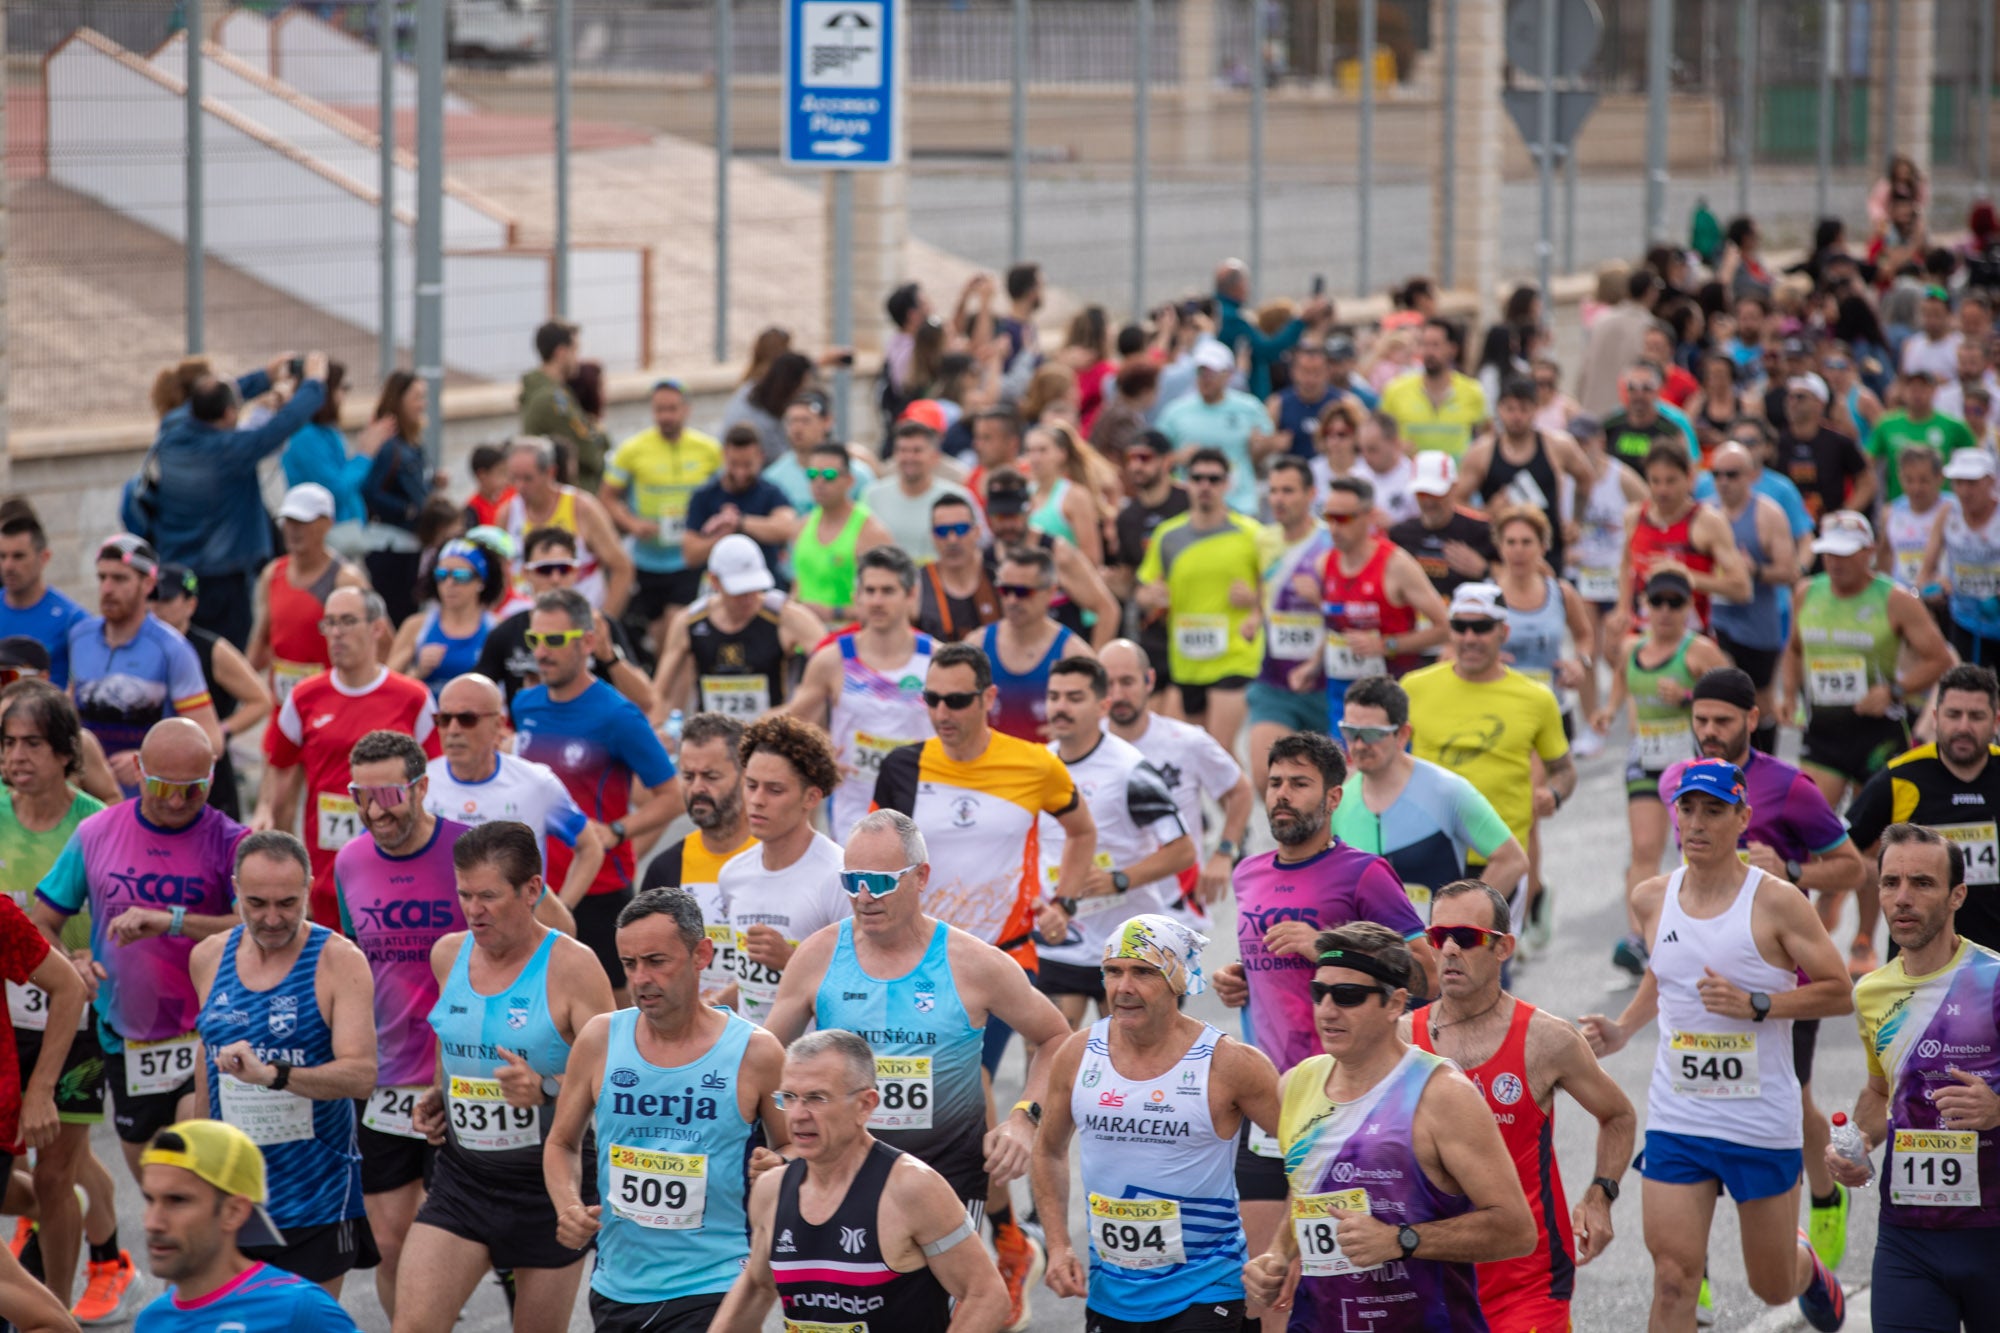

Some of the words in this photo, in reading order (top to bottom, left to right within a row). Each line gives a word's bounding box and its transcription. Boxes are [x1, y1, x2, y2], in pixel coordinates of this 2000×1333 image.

[1818, 673, 1857, 692] 792
[382, 900, 454, 929] cas
[848, 1028, 937, 1045] MUÑÉCAR
[1942, 1043, 1991, 1053] Arrebola
[140, 1047, 193, 1076] 578
[1682, 1055, 1743, 1081] 540
[613, 1087, 718, 1125] nerja
[876, 1083, 928, 1110] 86
[452, 1102, 534, 1131] 3319
[1086, 1114, 1190, 1137] MARACENA
[627, 1127, 702, 1143] ATLETISMO
[1129, 1137, 1176, 1145] ATLETISMO
[1913, 1138, 1957, 1149] FONDO
[621, 1151, 635, 1165] 38
[634, 1157, 684, 1172] FONDO
[1903, 1156, 1962, 1186] 119
[621, 1174, 687, 1209] 509
[1109, 1206, 1157, 1218] FONDO
[1102, 1222, 1166, 1252] 694
[793, 1292, 884, 1315] rundata
